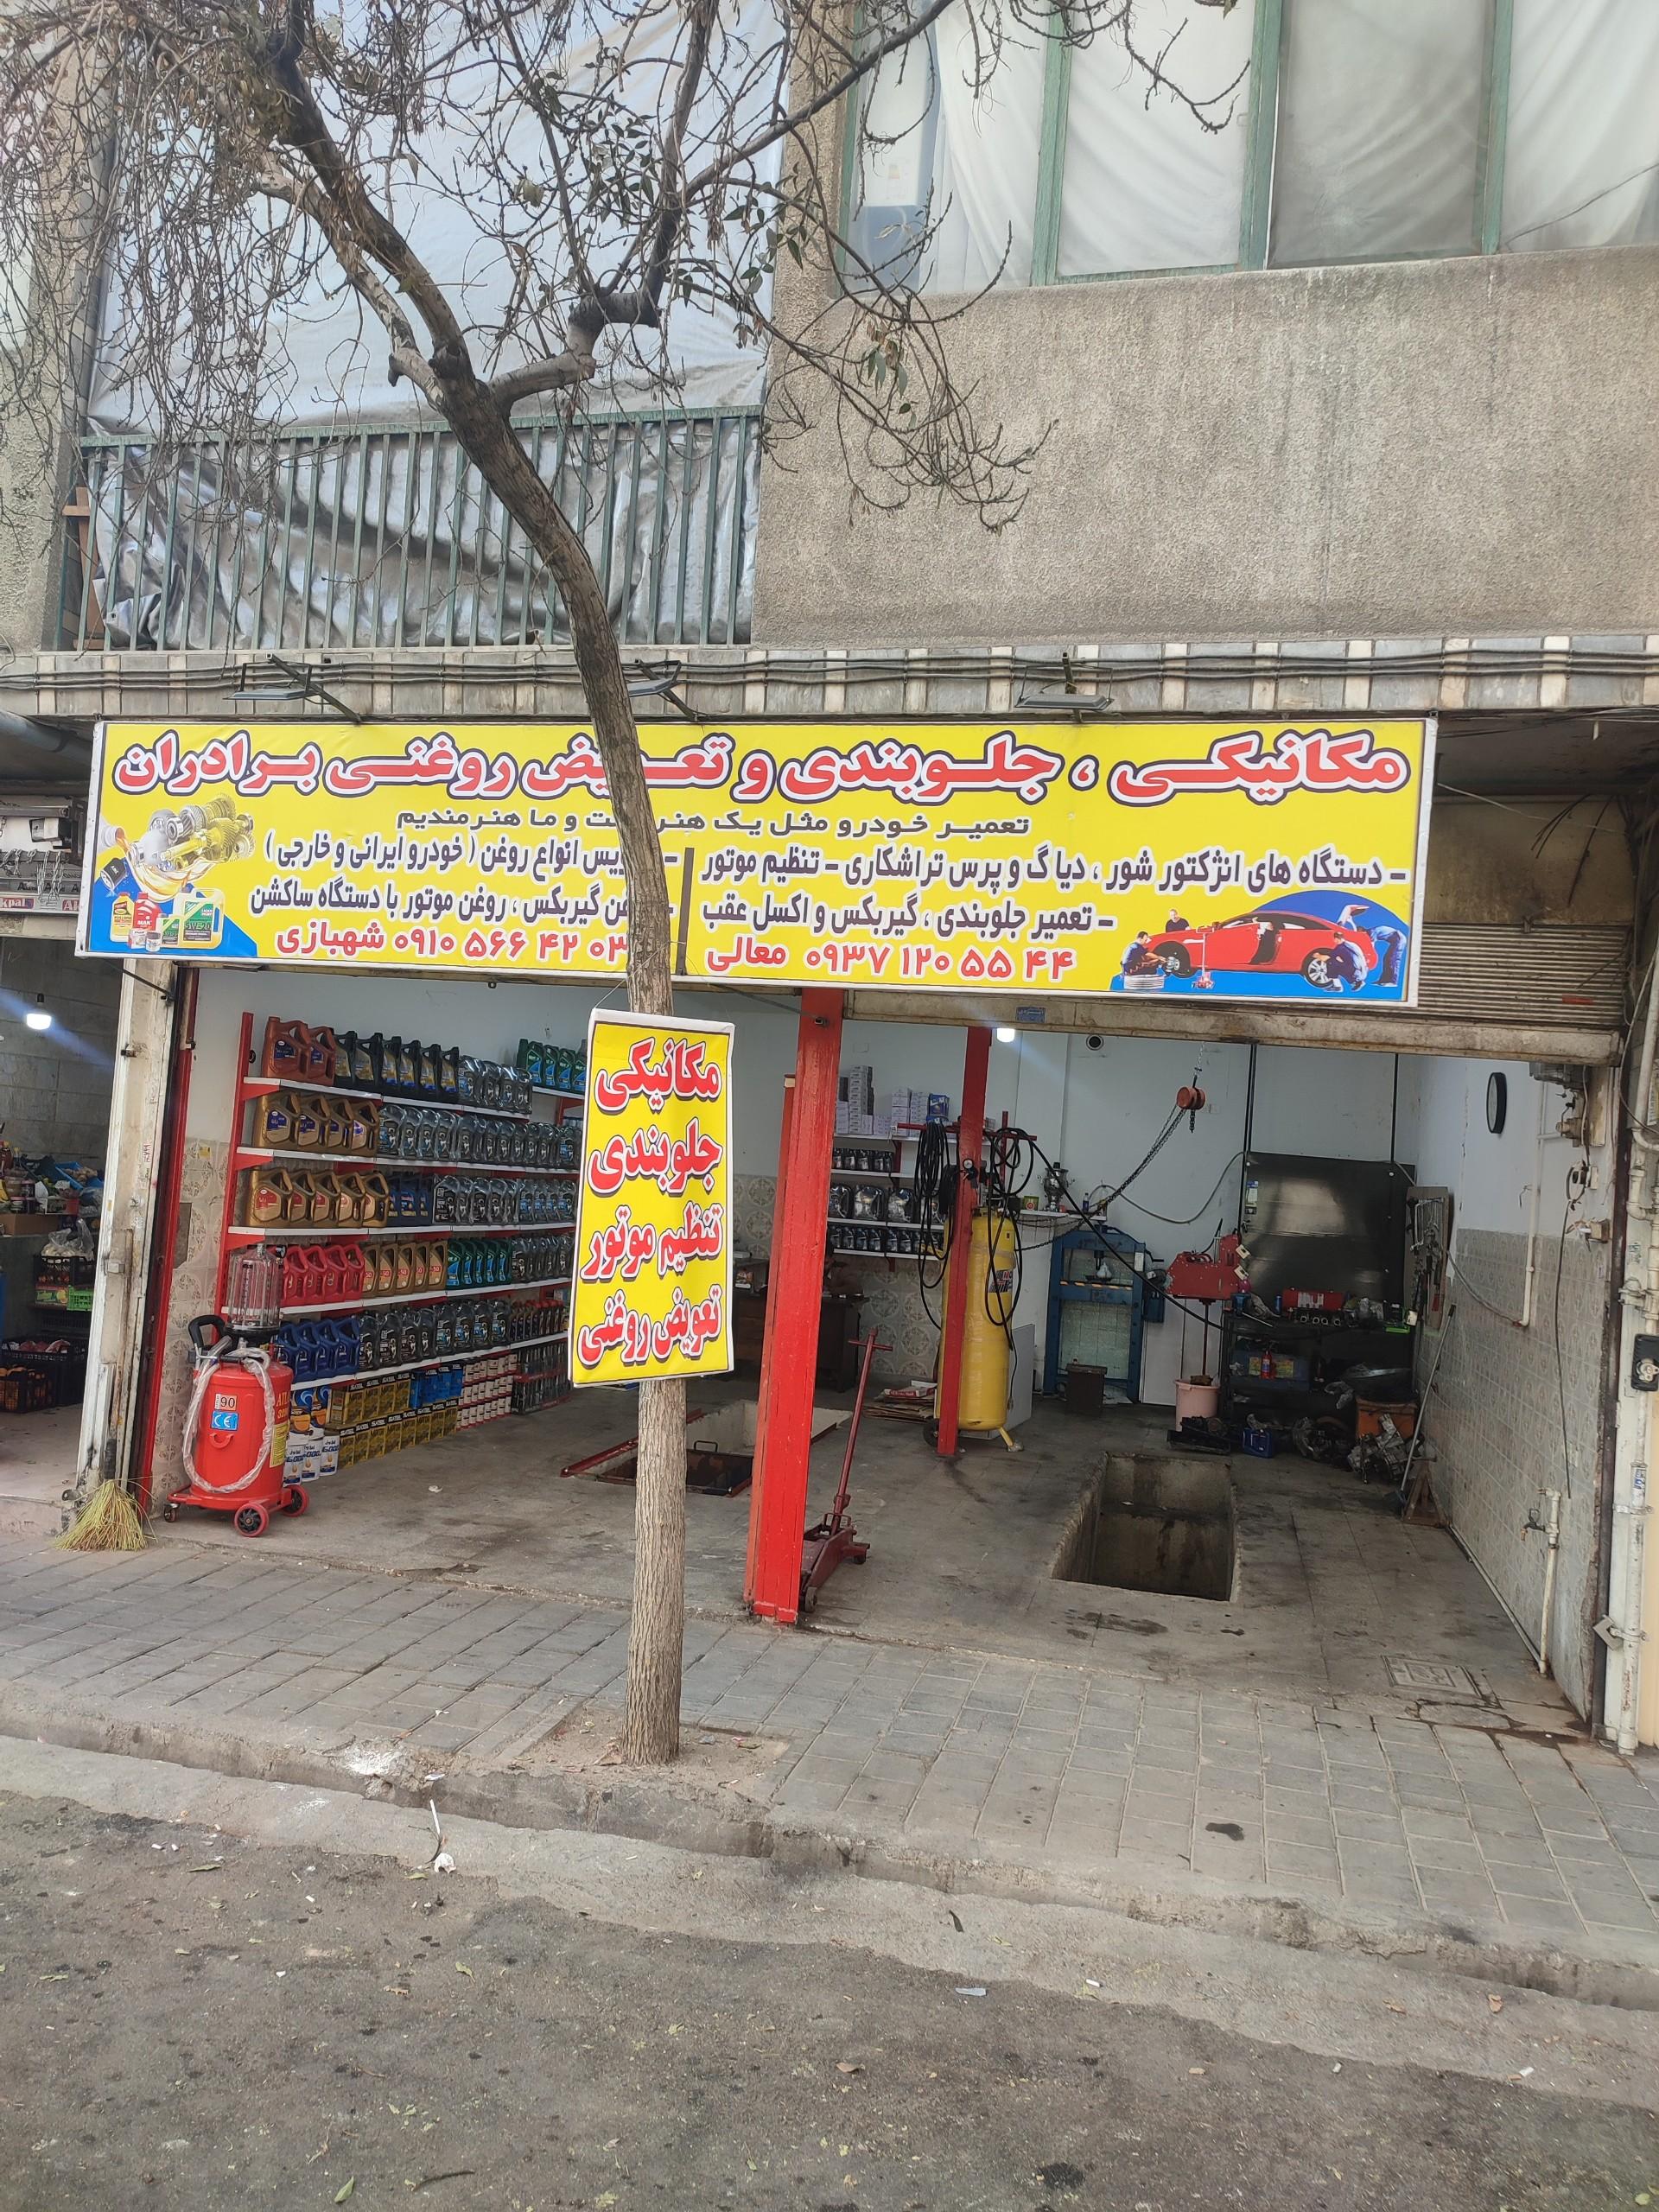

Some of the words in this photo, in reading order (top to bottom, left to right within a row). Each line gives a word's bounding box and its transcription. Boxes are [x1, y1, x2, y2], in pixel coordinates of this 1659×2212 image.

[112, 730, 322, 797] برادران
[326, 733, 519, 799] روغنی
[519, 733, 735, 799] تعیض
[731, 748, 777, 802] و
[779, 731, 1064, 804] جلوبندی
[1109, 731, 1409, 807] مکانیکی
[530, 809, 557, 826] ما
[564, 814, 577, 831] و
[657, 813, 705, 834] هنر
[714, 810, 761, 836] یک
[770, 812, 829, 836] مثل
[837, 815, 928, 838] خودرو
[936, 818, 1029, 840] تعمیر
[334, 842, 345, 868] و
[350, 835, 404, 870] ایرانی
[480, 836, 529, 873] روغن
[532, 839, 579, 882] انواع
[701, 849, 757, 882] موتور
[761, 846, 819, 883] تنظیم
[845, 846, 944, 887] تراشکاری
[1027, 843, 1085, 889] دیاگ
[1106, 849, 1153, 891] شور
[1299, 847, 1382, 885] دستگاه
[949, 861, 1002, 894] پرس
[1007, 859, 1020, 888] و
[1159, 849, 1241, 893] انژکتور
[1248, 853, 1292, 893] های
[251, 877, 314, 914] ساکشن
[318, 875, 380, 909] دستگاه
[386, 882, 398, 918] با
[403, 887, 454, 920] موتور
[458, 886, 506, 922] روغن
[524, 883, 600, 925] گیربکس
[703, 893, 747, 929] عقب
[753, 893, 809, 931] اکسل
[813, 905, 825, 933] و
[831, 893, 918, 936] گیربکس
[938, 900, 1026, 939] جلوبندی
[1031, 906, 1092, 939] تعمیر
[276, 921, 385, 957] شهبازی
[394, 928, 454, 955] ۰۹۱۰
[464, 931, 526, 958] ۵۶۶
[539, 933, 578, 960] ۴۲
[707, 936, 786, 971] معالی
[806, 944, 890, 974] ۰۹۳۷
[902, 946, 950, 976] ۱۲۰
[960, 949, 1012, 978] ۵۵
[1026, 950, 1073, 979] ۴۴
[595, 1037, 723, 1113] مکانیکی
[588, 1117, 724, 1195] جلوبندی
[581, 1205, 658, 1281] موتور
[658, 1202, 724, 1278] تنظیم
[577, 1289, 652, 1365] روغنی
[652, 1284, 723, 1359] تعویض
[220, 1396, 236, 1408] 90
